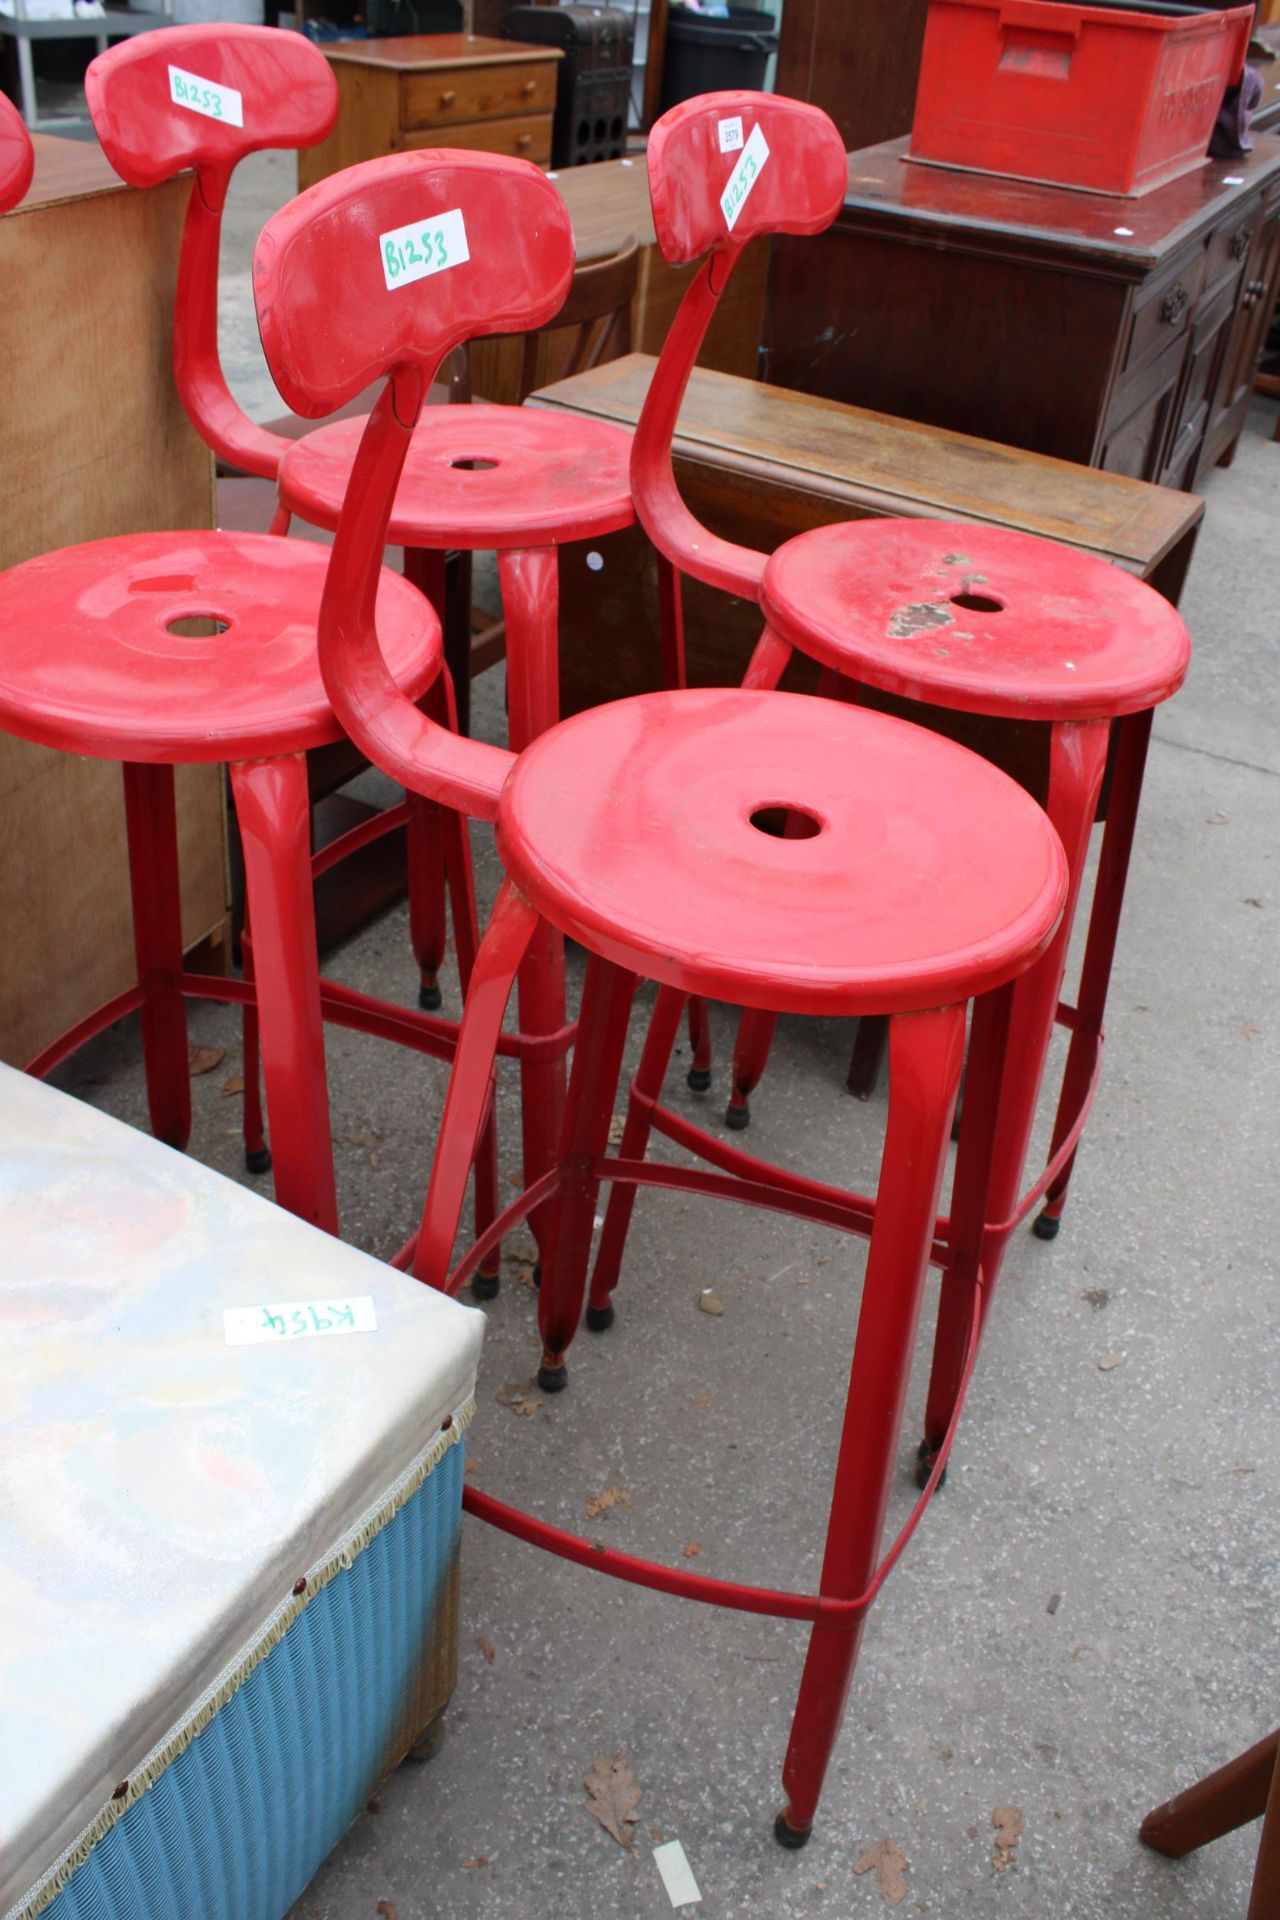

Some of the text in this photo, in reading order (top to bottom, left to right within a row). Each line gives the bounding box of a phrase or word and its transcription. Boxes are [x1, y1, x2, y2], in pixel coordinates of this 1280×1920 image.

[174, 75, 223, 117] B1253
[724, 154, 757, 219] B1253
[385, 230, 448, 278] B1253
[262, 1304, 355, 1335] K954
